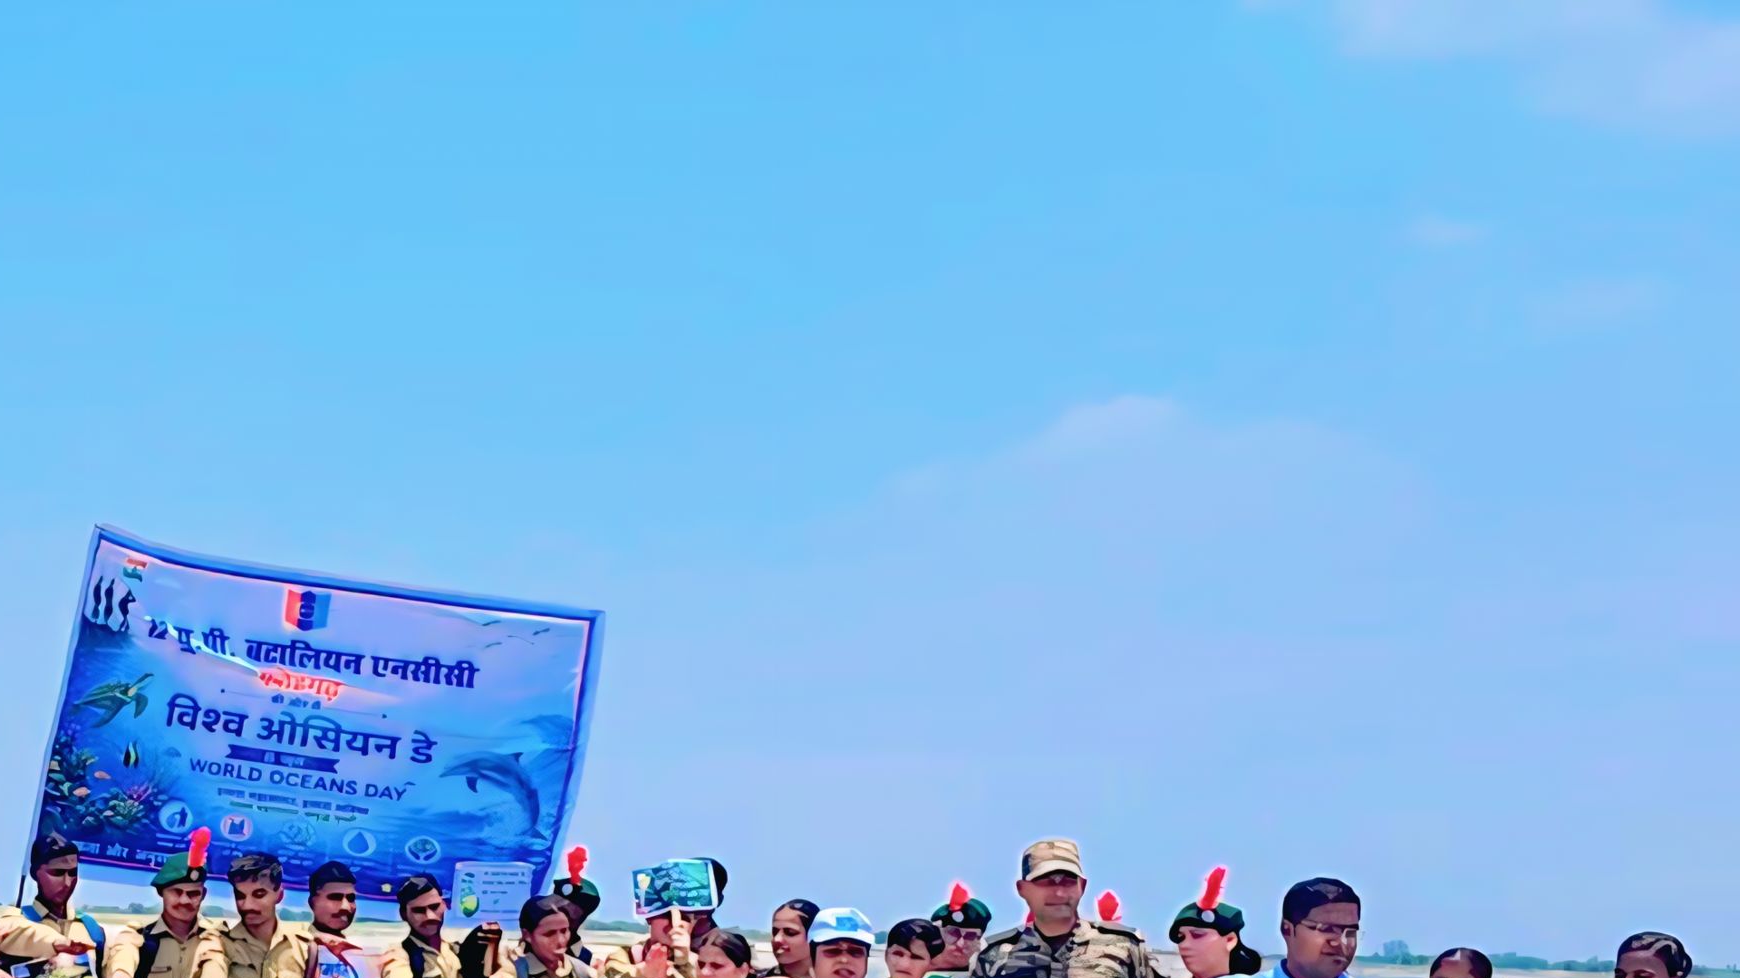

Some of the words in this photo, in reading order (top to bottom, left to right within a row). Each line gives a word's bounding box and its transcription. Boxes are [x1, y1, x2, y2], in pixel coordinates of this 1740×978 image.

[245, 638, 365, 676] बटालियन
[371, 655, 480, 689] एनसीसी
[166, 692, 249, 738] विश्व
[256, 710, 402, 760] ओसियन
[410, 729, 438, 764] डे
[189, 757, 263, 782] WORLD
[269, 769, 359, 796] OCEANS
[364, 783, 408, 801] DAY
